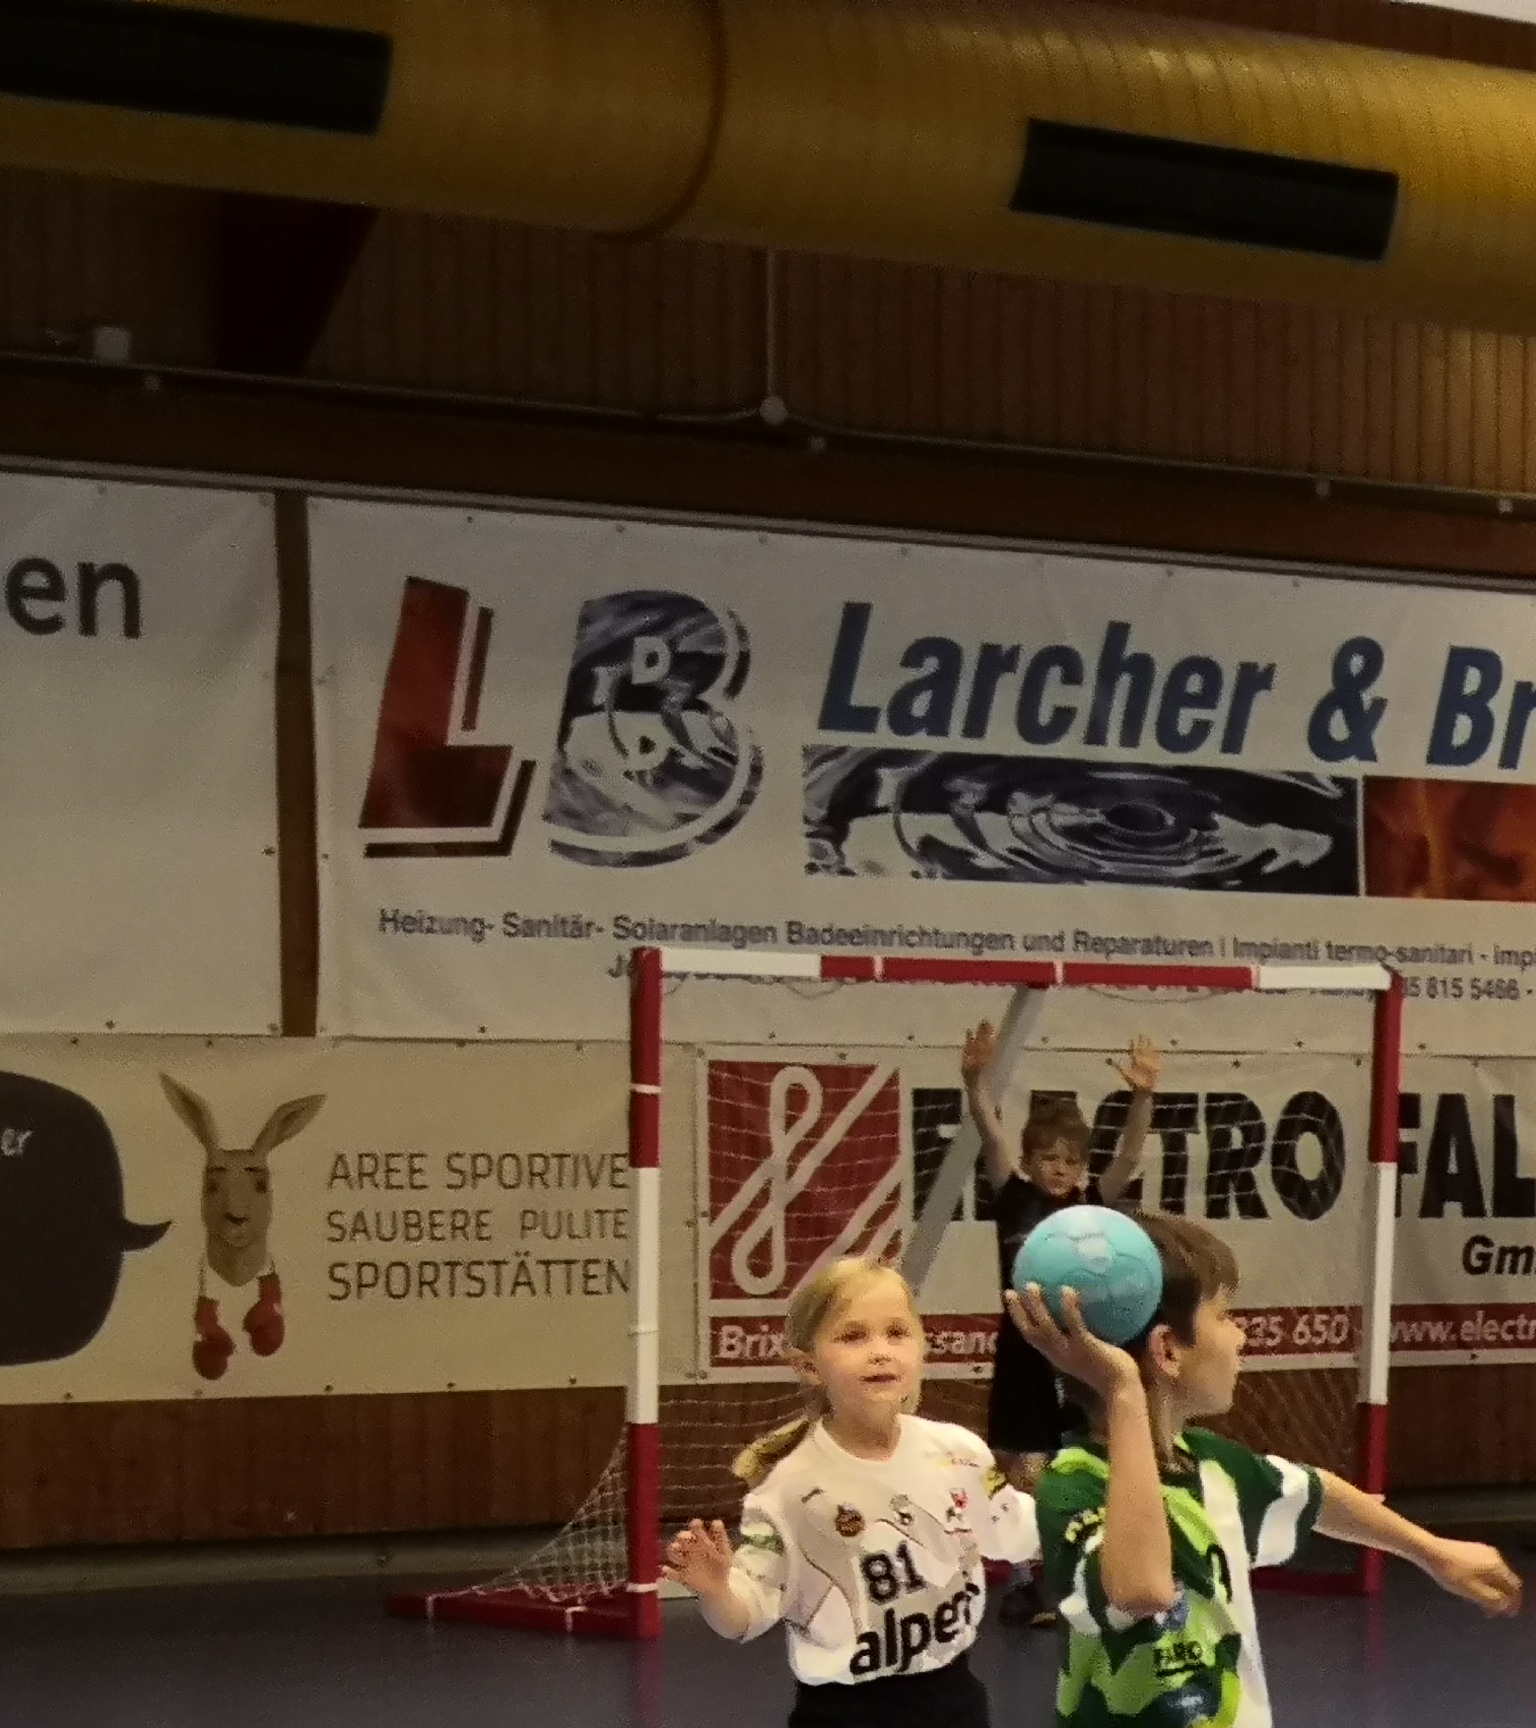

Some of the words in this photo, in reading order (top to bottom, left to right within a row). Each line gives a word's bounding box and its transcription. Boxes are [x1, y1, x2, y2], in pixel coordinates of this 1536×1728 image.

[3, 556, 143, 640] en
[816, 600, 1278, 756] Larcher
[1306, 634, 1389, 764] &
[326, 1150, 428, 1191] AREE
[446, 1151, 633, 1190] SPORTIVE
[326, 1207, 493, 1243] SAUBERE
[519, 1206, 631, 1240] PULITE
[327, 1251, 632, 1301] SPORTSTÄTTEN
[1292, 1312, 1350, 1347] 650
[860, 1539, 923, 1605] 81
